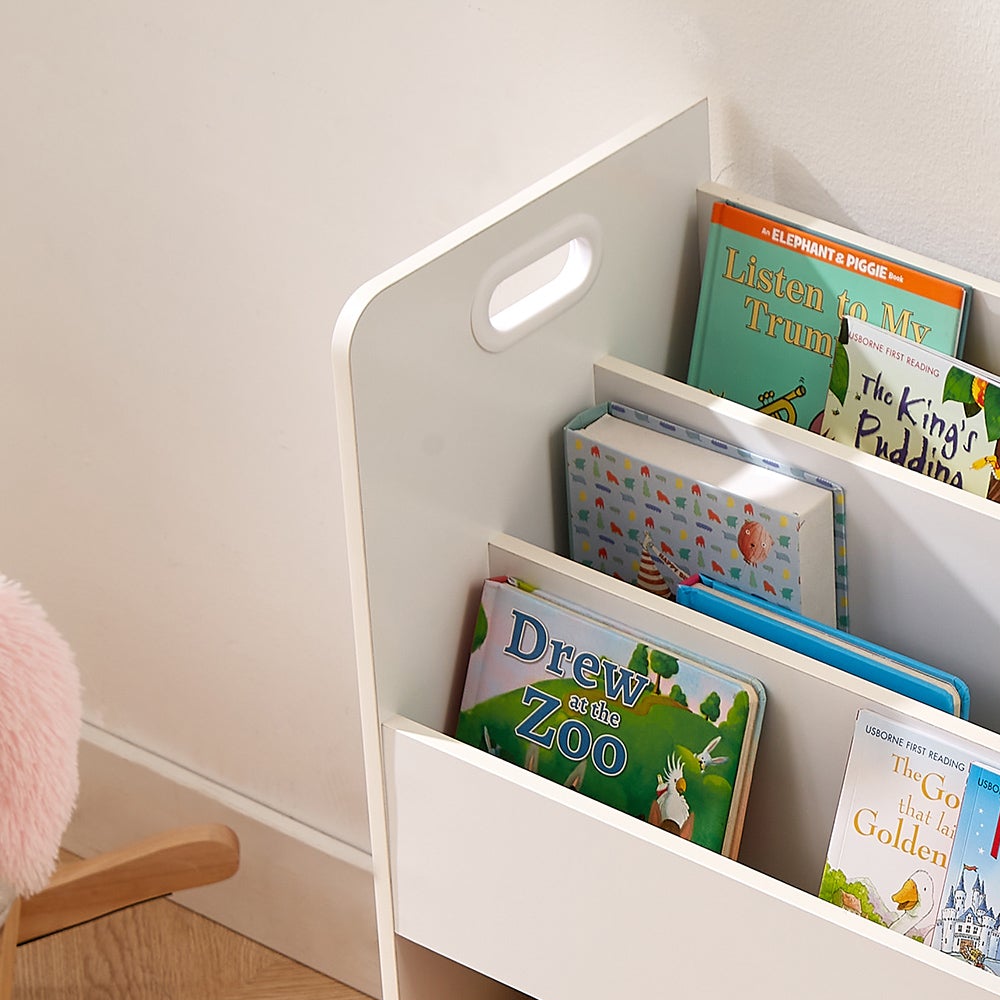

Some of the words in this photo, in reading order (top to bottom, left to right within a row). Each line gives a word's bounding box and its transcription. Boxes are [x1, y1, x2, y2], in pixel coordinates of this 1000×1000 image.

[722, 246, 824, 313] Listen
[762, 228, 771, 236] An
[772, 228, 836, 261] ELEPHANT
[835, 253, 845, 265] &
[846, 254, 888, 280] PIGGIE
[888, 272, 904, 284] Book
[744, 296, 836, 359] Trum
[849, 332, 885, 353] USBORNE
[886, 347, 905, 362] FIRST
[906, 356, 940, 378] READING
[861, 372, 893, 406] The
[897, 385, 979, 460] King's
[854, 409, 965, 491] Pudding
[504, 609, 649, 708] Drew
[515, 686, 628, 777] Zoo
[569, 694, 588, 715] at
[590, 700, 621, 728] the
[865, 725, 905, 748] USBORNE
[905, 740, 927, 757] FIRST
[929, 749, 966, 773] READING
[890, 753, 922, 783] The
[853, 807, 948, 871] Golden
[898, 795, 934, 826] that
